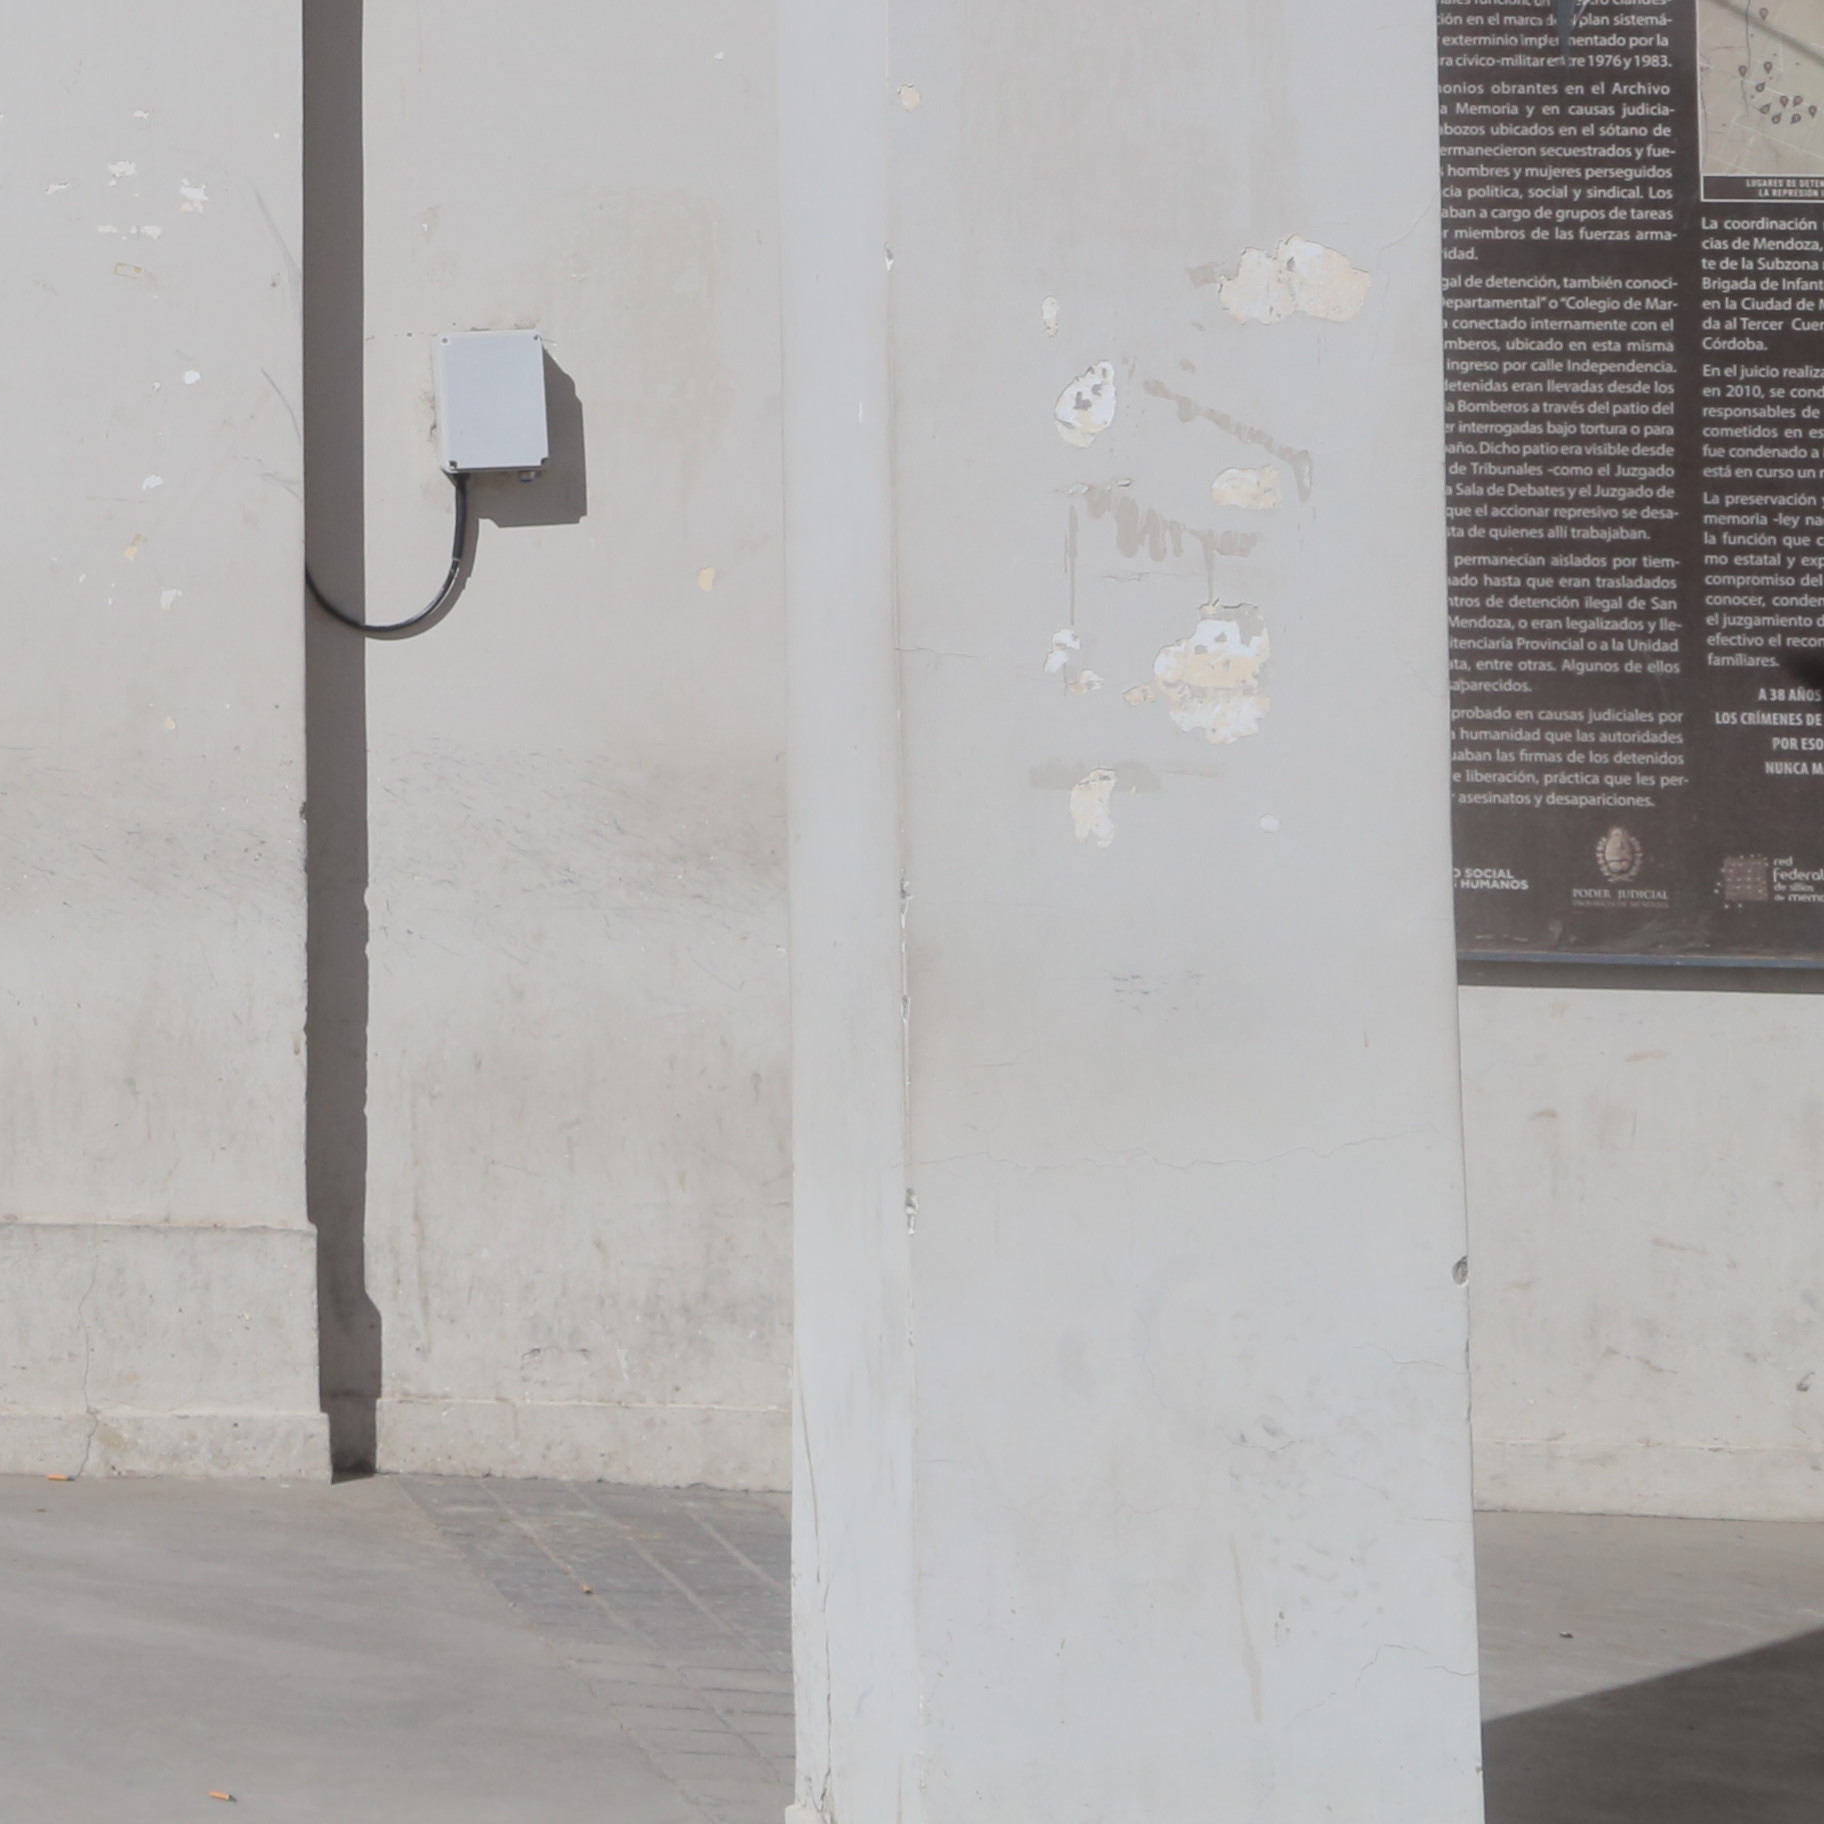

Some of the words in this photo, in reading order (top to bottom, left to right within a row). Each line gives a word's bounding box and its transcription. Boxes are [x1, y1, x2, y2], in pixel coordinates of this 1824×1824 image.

[1442, 34, 1518, 46] exterminio
[1629, 36, 1653, 48] por
[1656, 33, 1668, 46] la
[1587, 54, 1621, 66] 1976
[1622, 57, 1632, 69] y
[1633, 54, 1672, 67] 1983.
[1491, 81, 1557, 94] obrantes
[1564, 85, 1583, 94] en
[1591, 81, 1604, 94] el
[1612, 82, 1670, 94] Archivo
[1455, 102, 1518, 114] Memoria
[1526, 105, 1534, 117] y
[1542, 105, 1559, 114] en
[1568, 105, 1614, 115] causas
[1539, 143, 1631, 157] secuestrados
[1635, 147, 1643, 159] y
[1447, 163, 1509, 177] hombres
[1512, 167, 1521, 179] y
[1525, 165, 1581, 180] mujeres
[1585, 165, 1672, 181] perseguidos
[1467, 184, 1522, 200] política,
[1528, 185, 1567, 198] social
[1572, 188, 1581, 201] y
[1586, 185, 1643, 198] sindical.
[1649, 186, 1672, 198] Los
[1701, 217, 1717, 229] La
[1723, 217, 1816, 230] coordinación
[1454, 226, 1525, 239] miembros
[1530, 226, 1549, 239] de
[1555, 227, 1573, 239] las
[1579, 226, 1630, 240] fuerzas
[1701, 237, 1728, 249] cias
[1731, 237, 1749, 249] de
[1753, 237, 1823, 251] Mendoza,
[1464, 274, 1482, 287] de
[1485, 274, 1560, 289] detención,
[1563, 276, 1622, 288] también
[1548, 299, 1558, 308] o
[1623, 297, 1641, 309] de
[1451, 316, 1526, 329] conectado
[1531, 317, 1627, 330] internamente
[1630, 321, 1656, 330] con
[1661, 318, 1673, 330] el
[1702, 337, 1767, 350] Córdoba.
[1446, 357, 1498, 374] ingreso
[1502, 361, 1527, 373] por
[1530, 358, 1563, 371] calle
[1567, 359, 1676, 374] Independencia.
[1511, 382, 1542, 391] eran
[1547, 379, 1603, 392] llevadas
[1607, 380, 1650, 393] desde
[1654, 381, 1674, 393] los
[1702, 387, 1720, 396] en
[1726, 384, 1764, 398] 2010,
[1769, 388, 1785, 397] se
[1703, 404, 1795, 420] responsables
[1801, 405, 1819, 418] de
[1458, 420, 1543, 437] interrogadas
[1546, 421, 1576, 437] bajo
[1579, 423, 1626, 434] tortura
[1630, 425, 1640, 434] o
[1643, 425, 1673, 437] para
[1702, 443, 1725, 457] fue
[1728, 444, 1807, 458] condenado
[1810, 448, 1819, 458] a
[1448, 461, 1467, 475] de
[1469, 462, 1542, 475] Tribunales
[1547, 465, 1592, 475] -como
[1597, 463, 1609, 476] el
[1615, 464, 1674, 479] Juzgado
[1703, 492, 1719, 504] La
[1725, 492, 1816, 507] preservación
[1454, 553, 1545, 569] permanecían
[1550, 553, 1607, 566] aislados
[1612, 557, 1636, 569] por
[1483, 573, 1520, 586] hasta
[1526, 577, 1553, 589] que
[1559, 577, 1590, 587] eran
[1595, 575, 1676, 588] trasladados
[1705, 573, 1795, 588] compromiso
[1800, 573, 1822, 586] del
[1706, 612, 1718, 625] el
[1722, 614, 1812, 630] juzgamiento
[1706, 632, 1763, 646] efectivo
[1768, 633, 1781, 646] el
[1707, 652, 1778, 666] familiares.
[1758, 689, 1767, 701] A
[1769, 689, 1786, 702] 38
[1452, 705, 1511, 722] probado
[1515, 710, 1533, 720] en
[1538, 710, 1584, 720] causas
[1588, 708, 1654, 724] judiciales
[1658, 712, 1682, 724] por
[1715, 712, 1737, 725] LOS
[1740, 710, 1803, 726] CRÍMENES
[1806, 713, 1823, 726] DE
[1772, 737, 1799, 750] POR
[1765, 761, 1809, 775] NUNCA
[1458, 791, 1531, 804] asesinatos
[1533, 795, 1542, 807] y
[1545, 791, 1654, 808] desapariciones.
[1465, 868, 1515, 879] SOCIAL
[1460, 879, 1529, 890] HUMANOS
[1572, 888, 1611, 899] PODER
[1617, 889, 1669, 900] JUDICIAL
